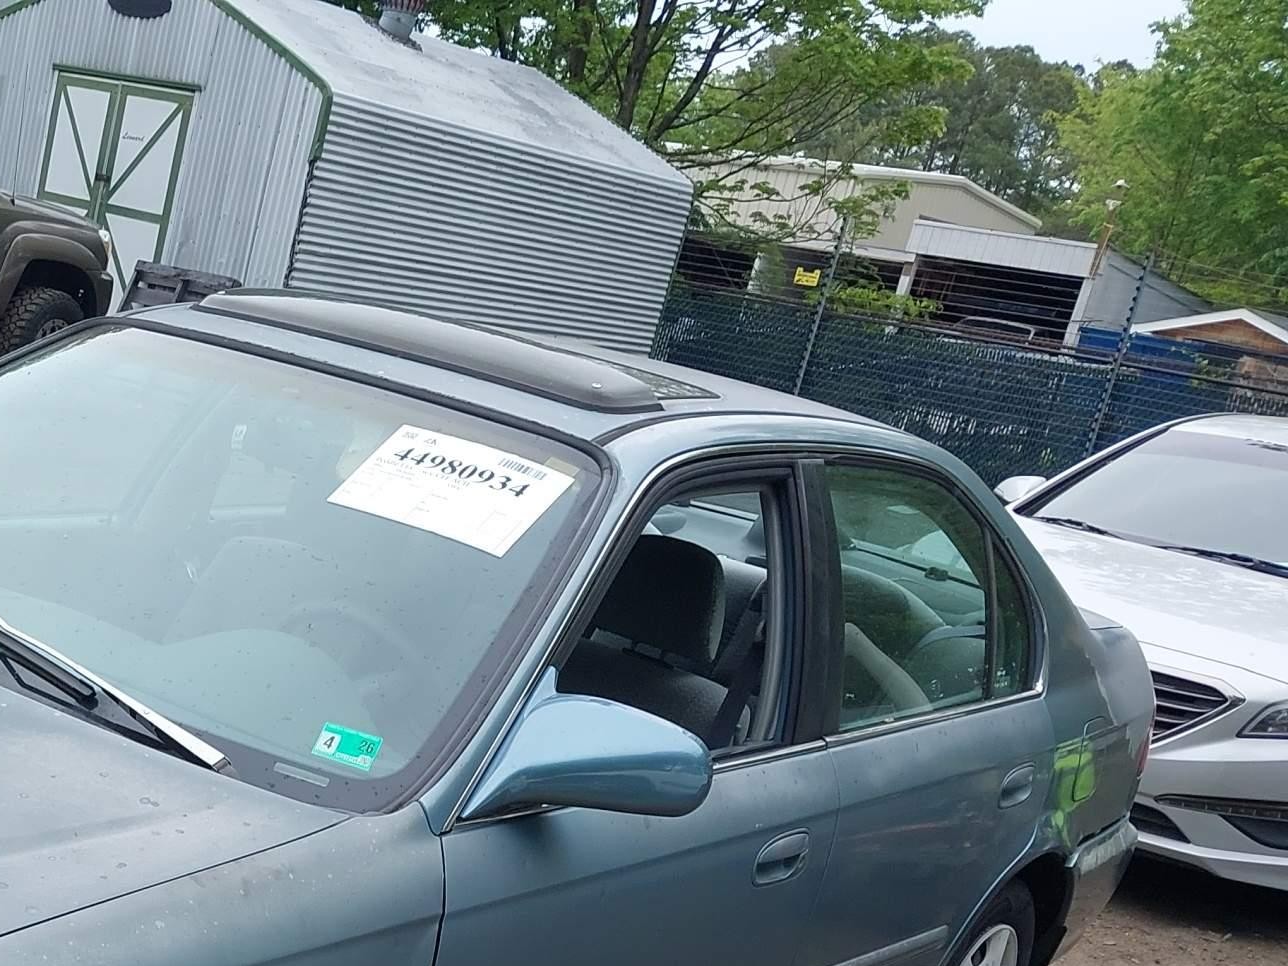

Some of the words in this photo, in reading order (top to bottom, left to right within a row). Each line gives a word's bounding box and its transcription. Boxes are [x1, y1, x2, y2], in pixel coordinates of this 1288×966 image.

[392, 446, 531, 498] 44980934
[322, 735, 336, 750] 4
[357, 739, 376, 754] 26
